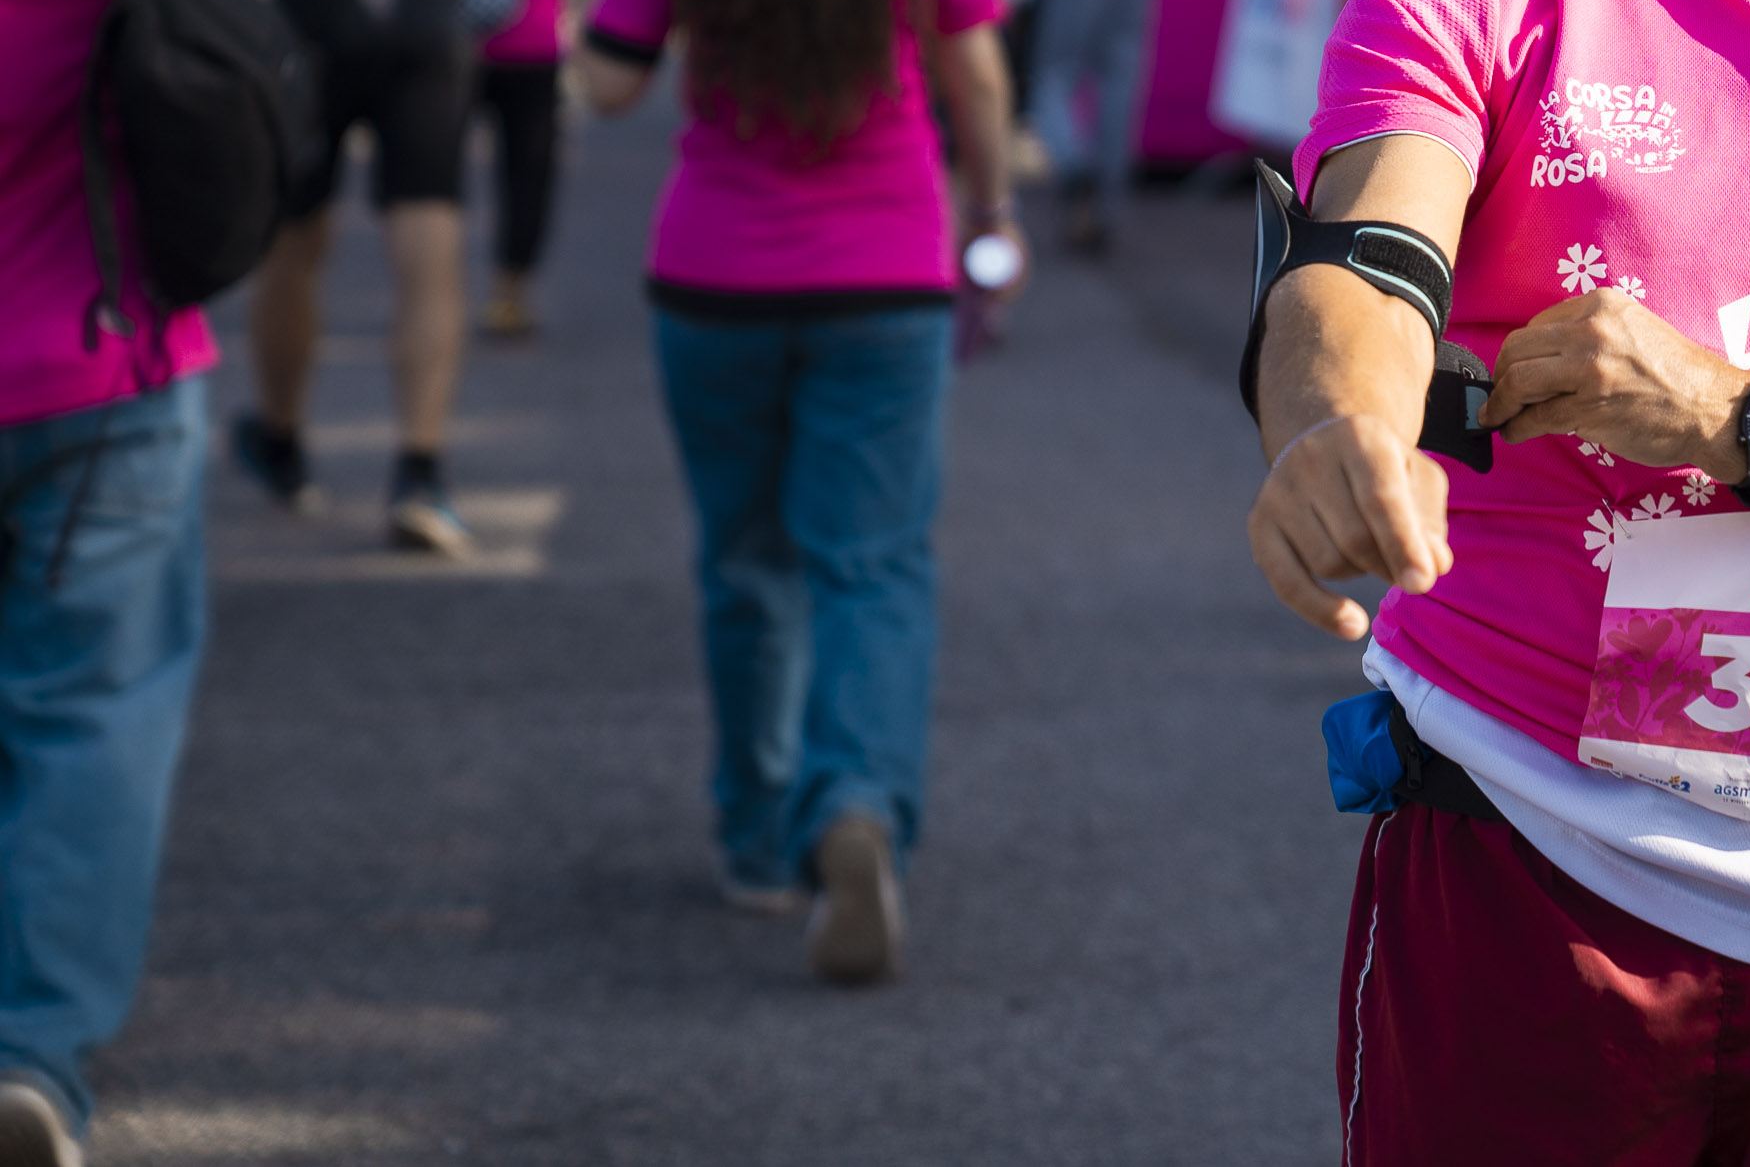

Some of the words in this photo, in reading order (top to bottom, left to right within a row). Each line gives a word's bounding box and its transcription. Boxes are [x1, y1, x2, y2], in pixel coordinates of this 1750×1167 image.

[1539, 91, 1560, 110] LA
[1566, 78, 1656, 111] CORSA
[1660, 101, 1677, 117] IN
[1530, 149, 1607, 187] ROSA
